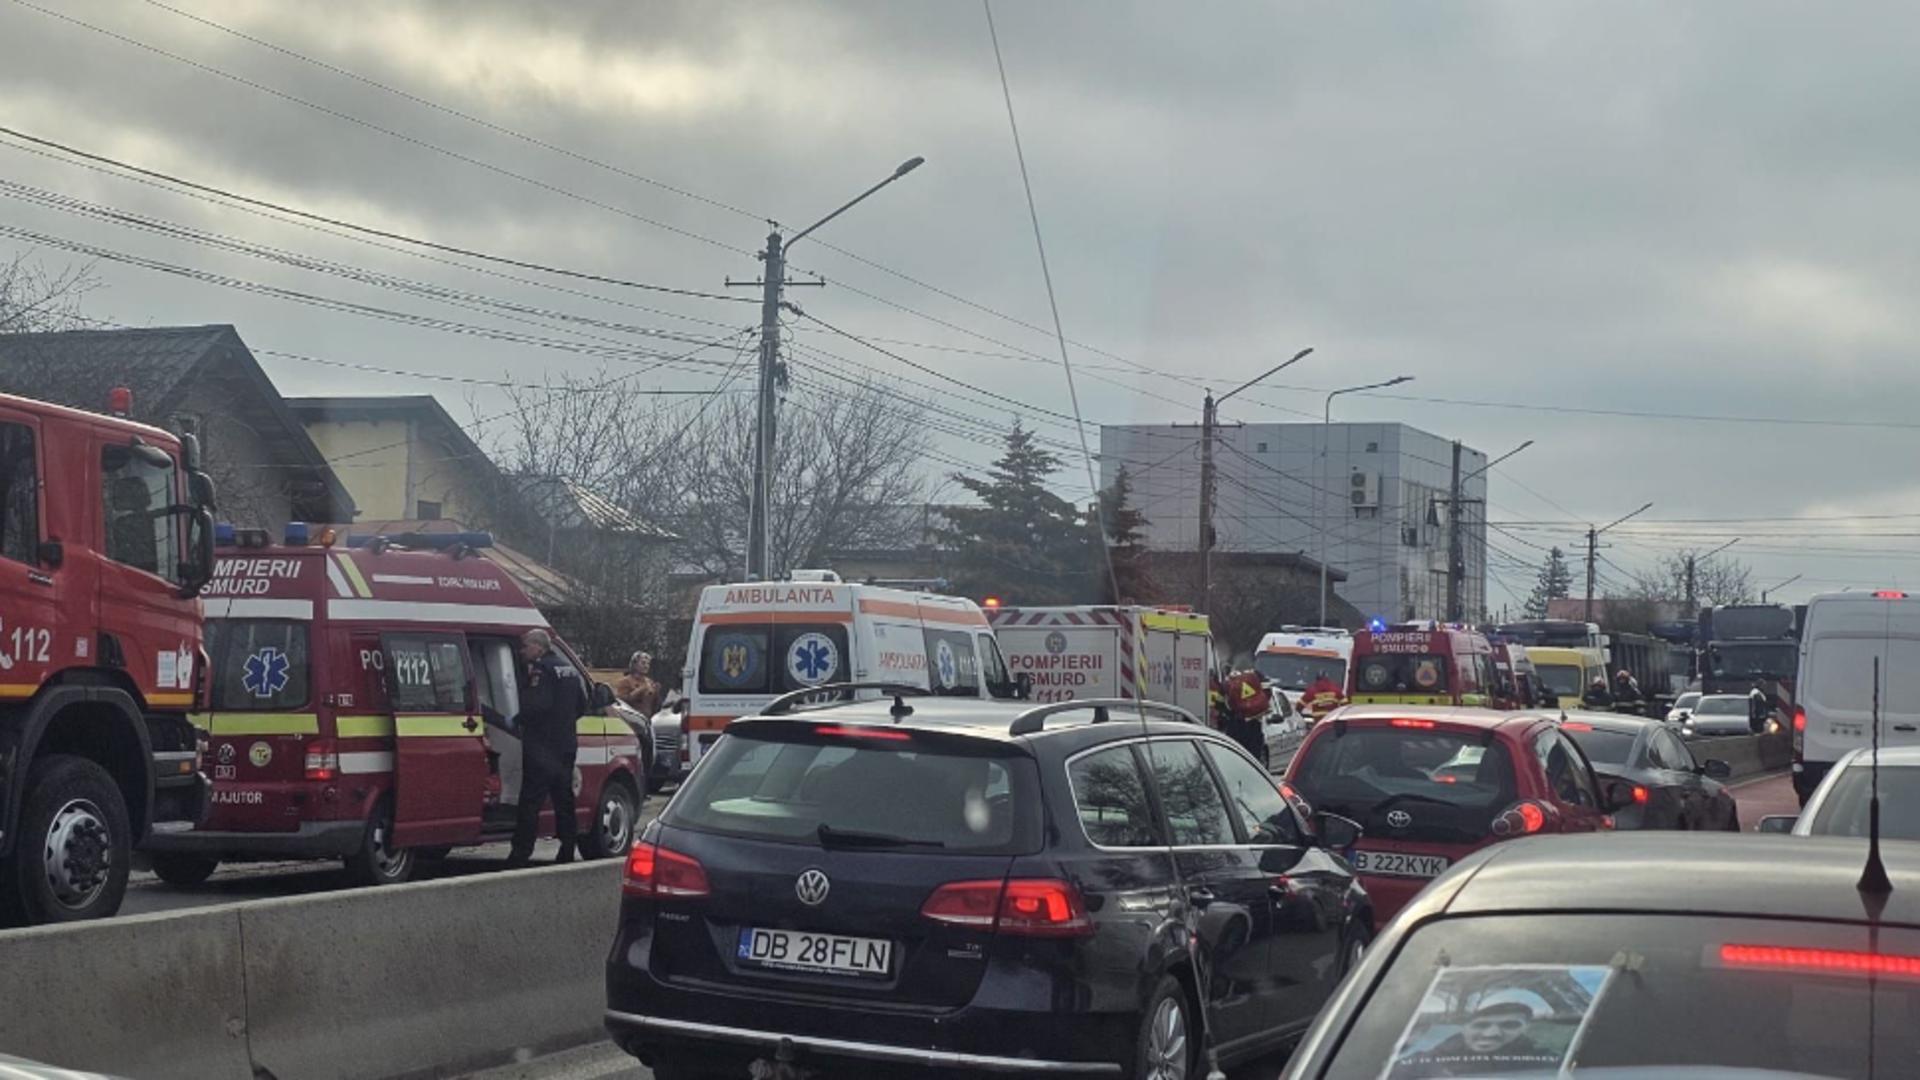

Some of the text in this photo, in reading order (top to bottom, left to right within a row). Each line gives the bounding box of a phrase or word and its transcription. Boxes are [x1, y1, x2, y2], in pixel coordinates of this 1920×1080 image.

[212, 559, 302, 578] MPIERII
[724, 587, 835, 605] AMBULANTA
[11, 627, 50, 662] 112
[1010, 654, 1104, 670] POMPIERII
[402, 659, 431, 685] 112
[1029, 671, 1086, 687] SMURD
[219, 791, 263, 804] AJUTOR
[1355, 853, 1441, 874] B 222KYK
[752, 931, 789, 959] DB
